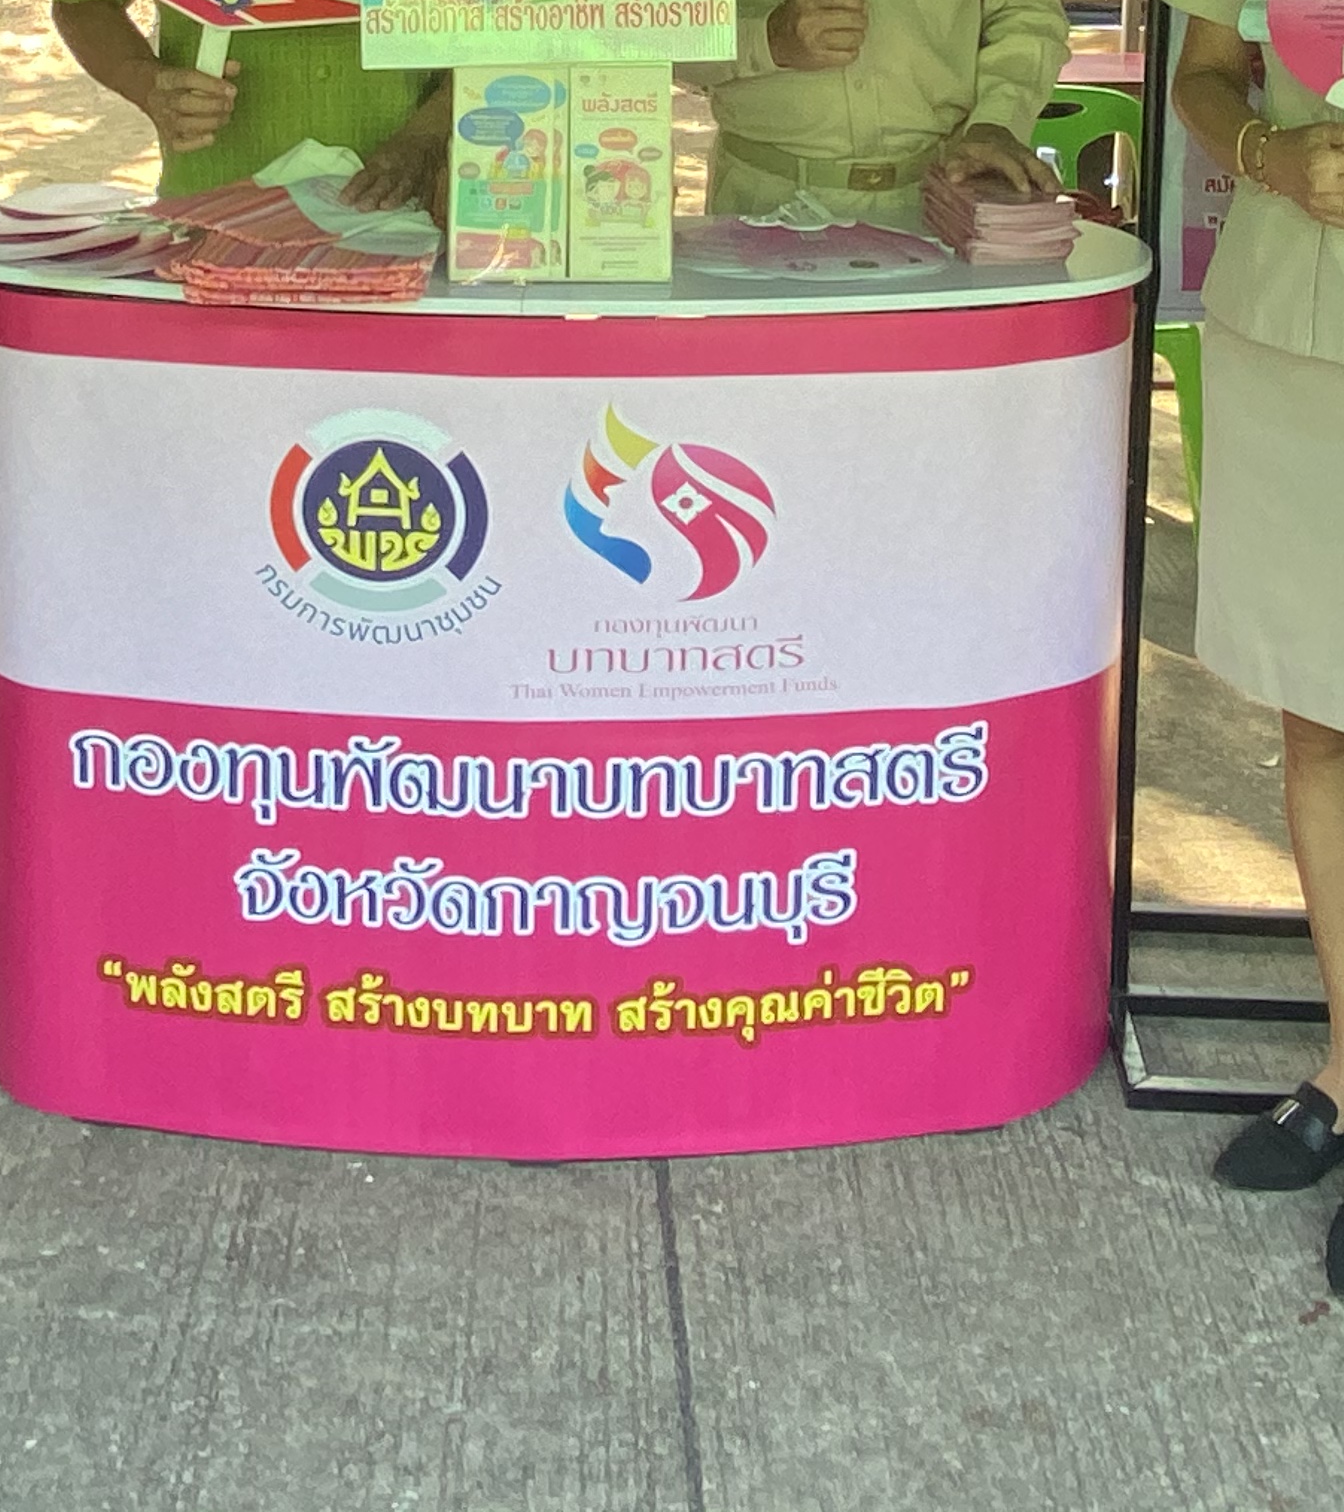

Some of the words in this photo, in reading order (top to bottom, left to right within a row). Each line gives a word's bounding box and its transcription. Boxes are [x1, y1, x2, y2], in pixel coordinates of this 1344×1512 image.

[582, 91, 657, 113] พลังสตรี
[254, 560, 503, 646] กรมการพัฒนาชุมชน
[594, 614, 758, 639] กองทุนพัฒนา
[548, 635, 805, 674] บทบาทสตรี
[511, 684, 553, 700] Thai
[560, 683, 632, 699] Women
[639, 680, 775, 701] Empowerment
[782, 676, 838, 693] Funds
[71, 724, 988, 822] กองทุนพัฒนาบทบาทสตรี
[237, 851, 857, 944] จังหวัดกาญจนบุรี
[327, 971, 593, 1035] สร้างบทบาท
